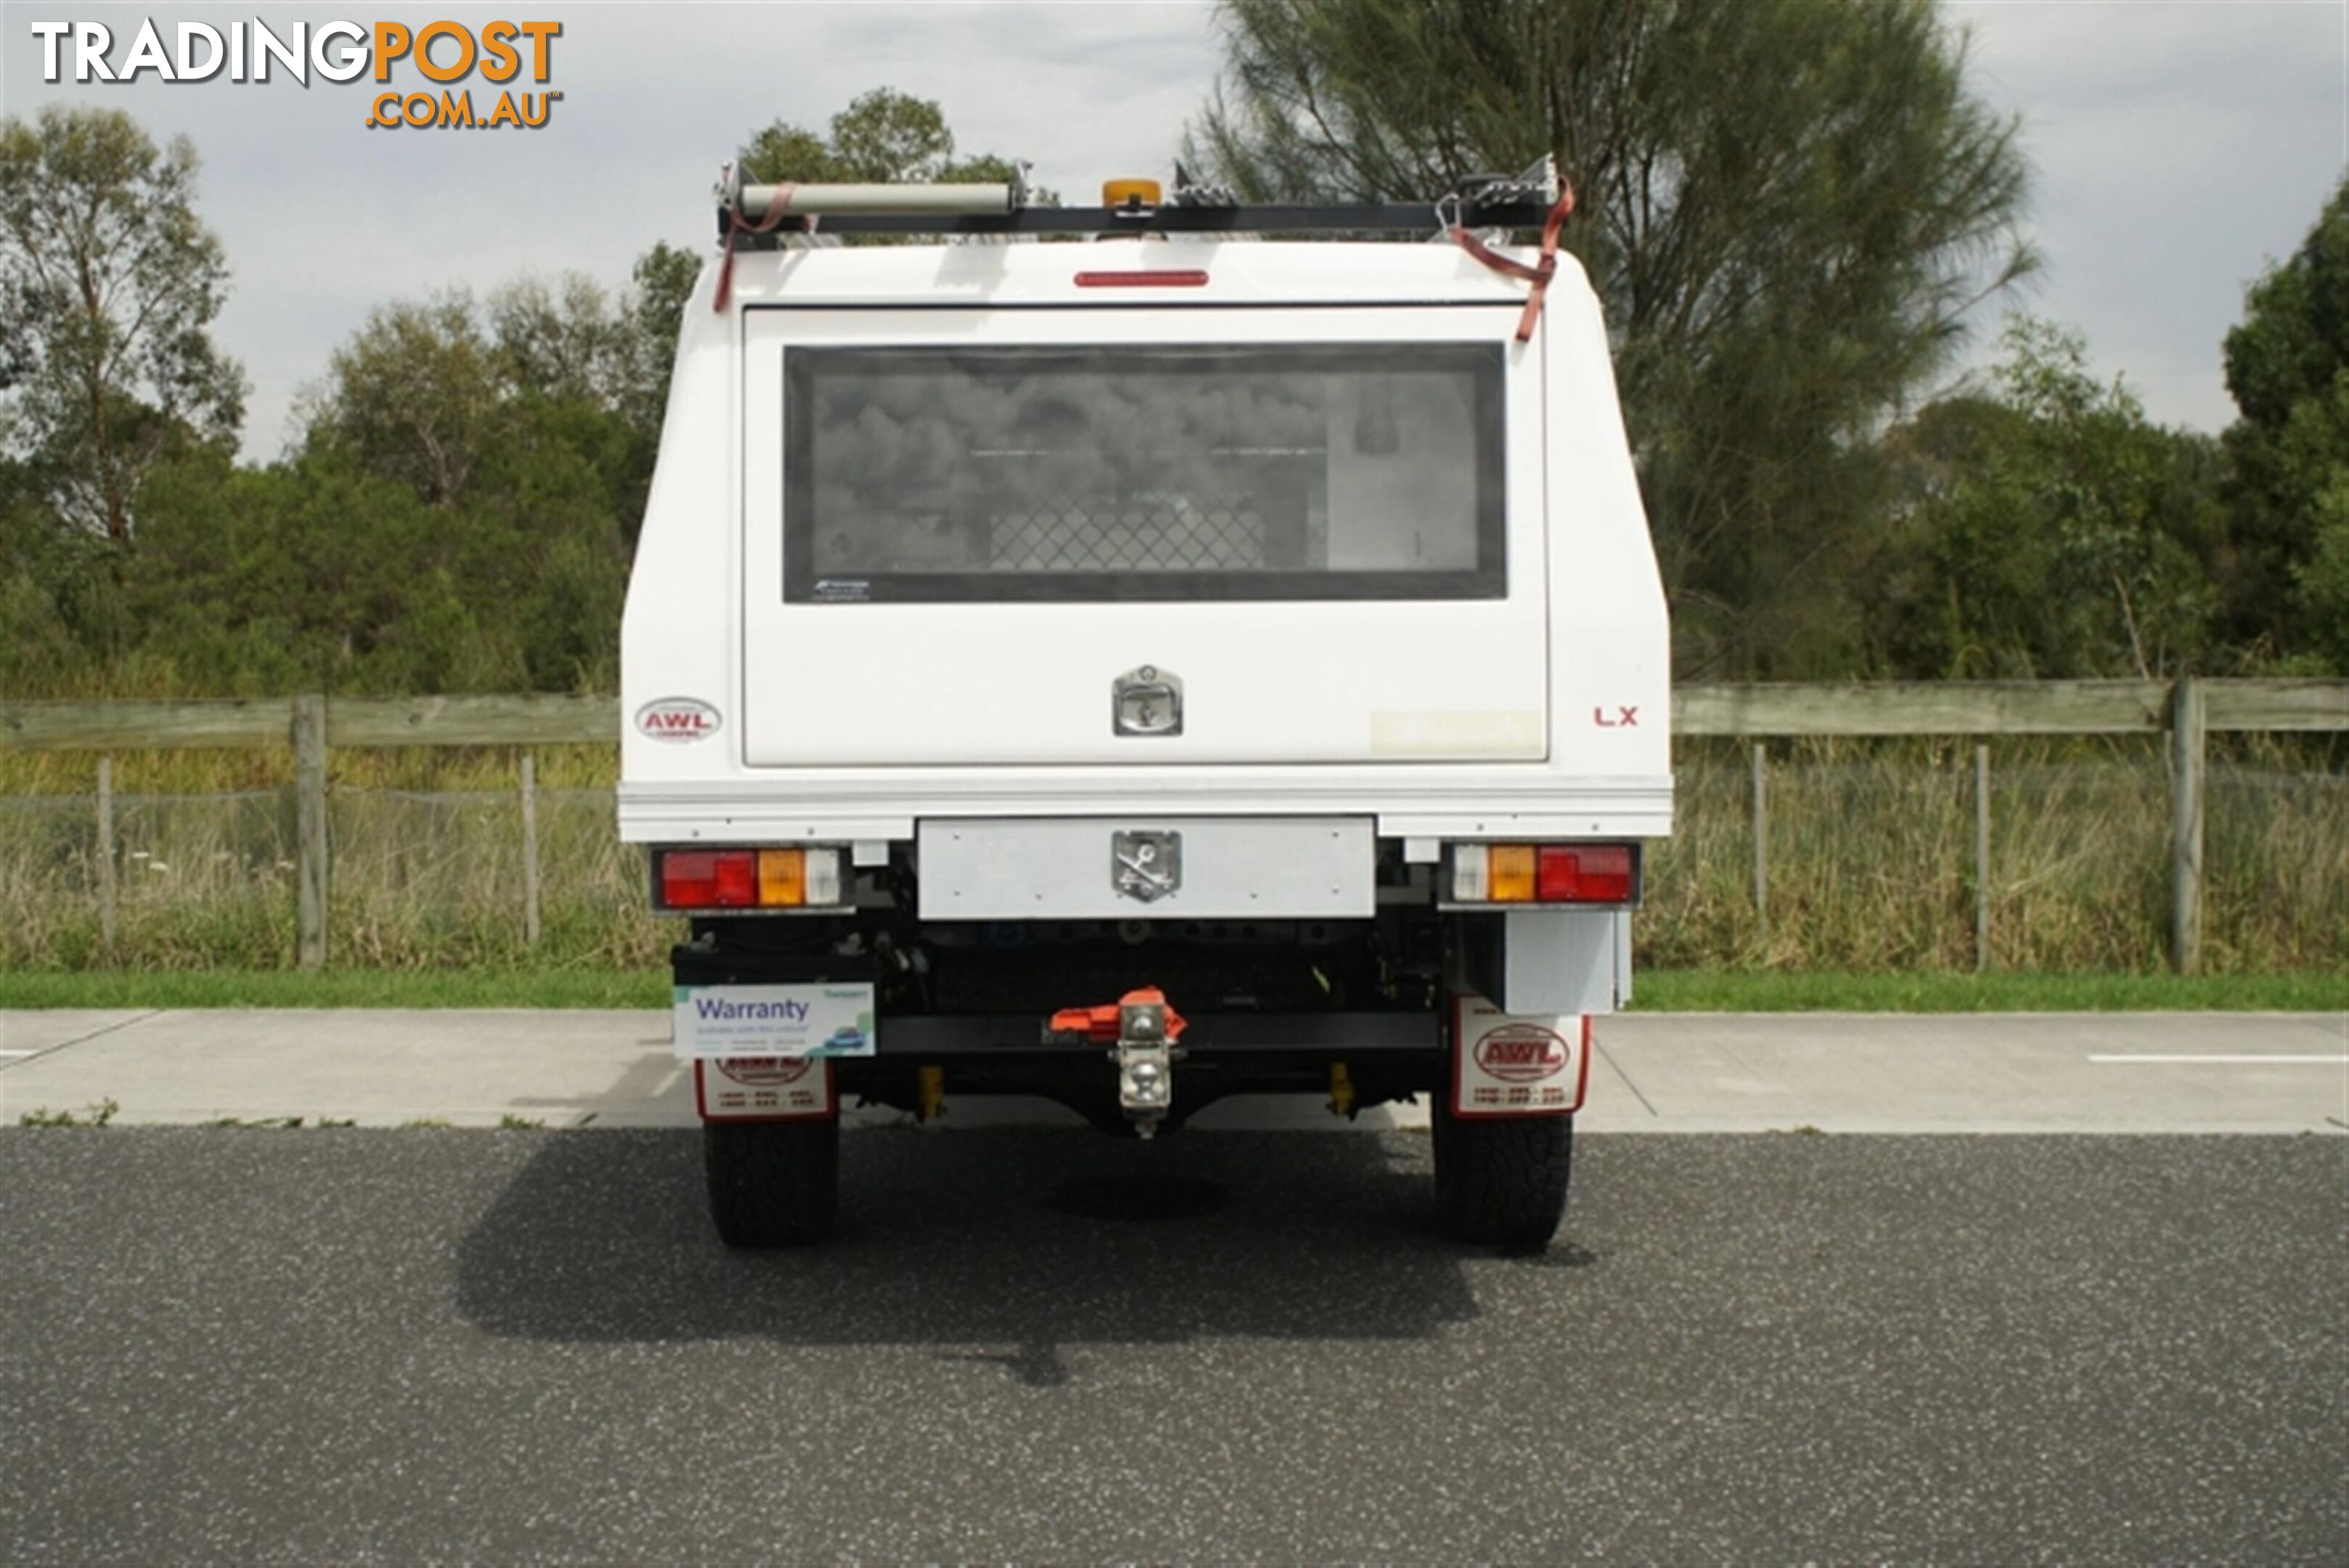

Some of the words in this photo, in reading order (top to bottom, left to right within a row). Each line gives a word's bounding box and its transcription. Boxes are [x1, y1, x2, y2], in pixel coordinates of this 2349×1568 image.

[645, 711, 713, 729] AWL
[1594, 706, 1638, 727] LX
[696, 997, 809, 1021] Warranty
[1481, 1040, 1563, 1064] AWL
